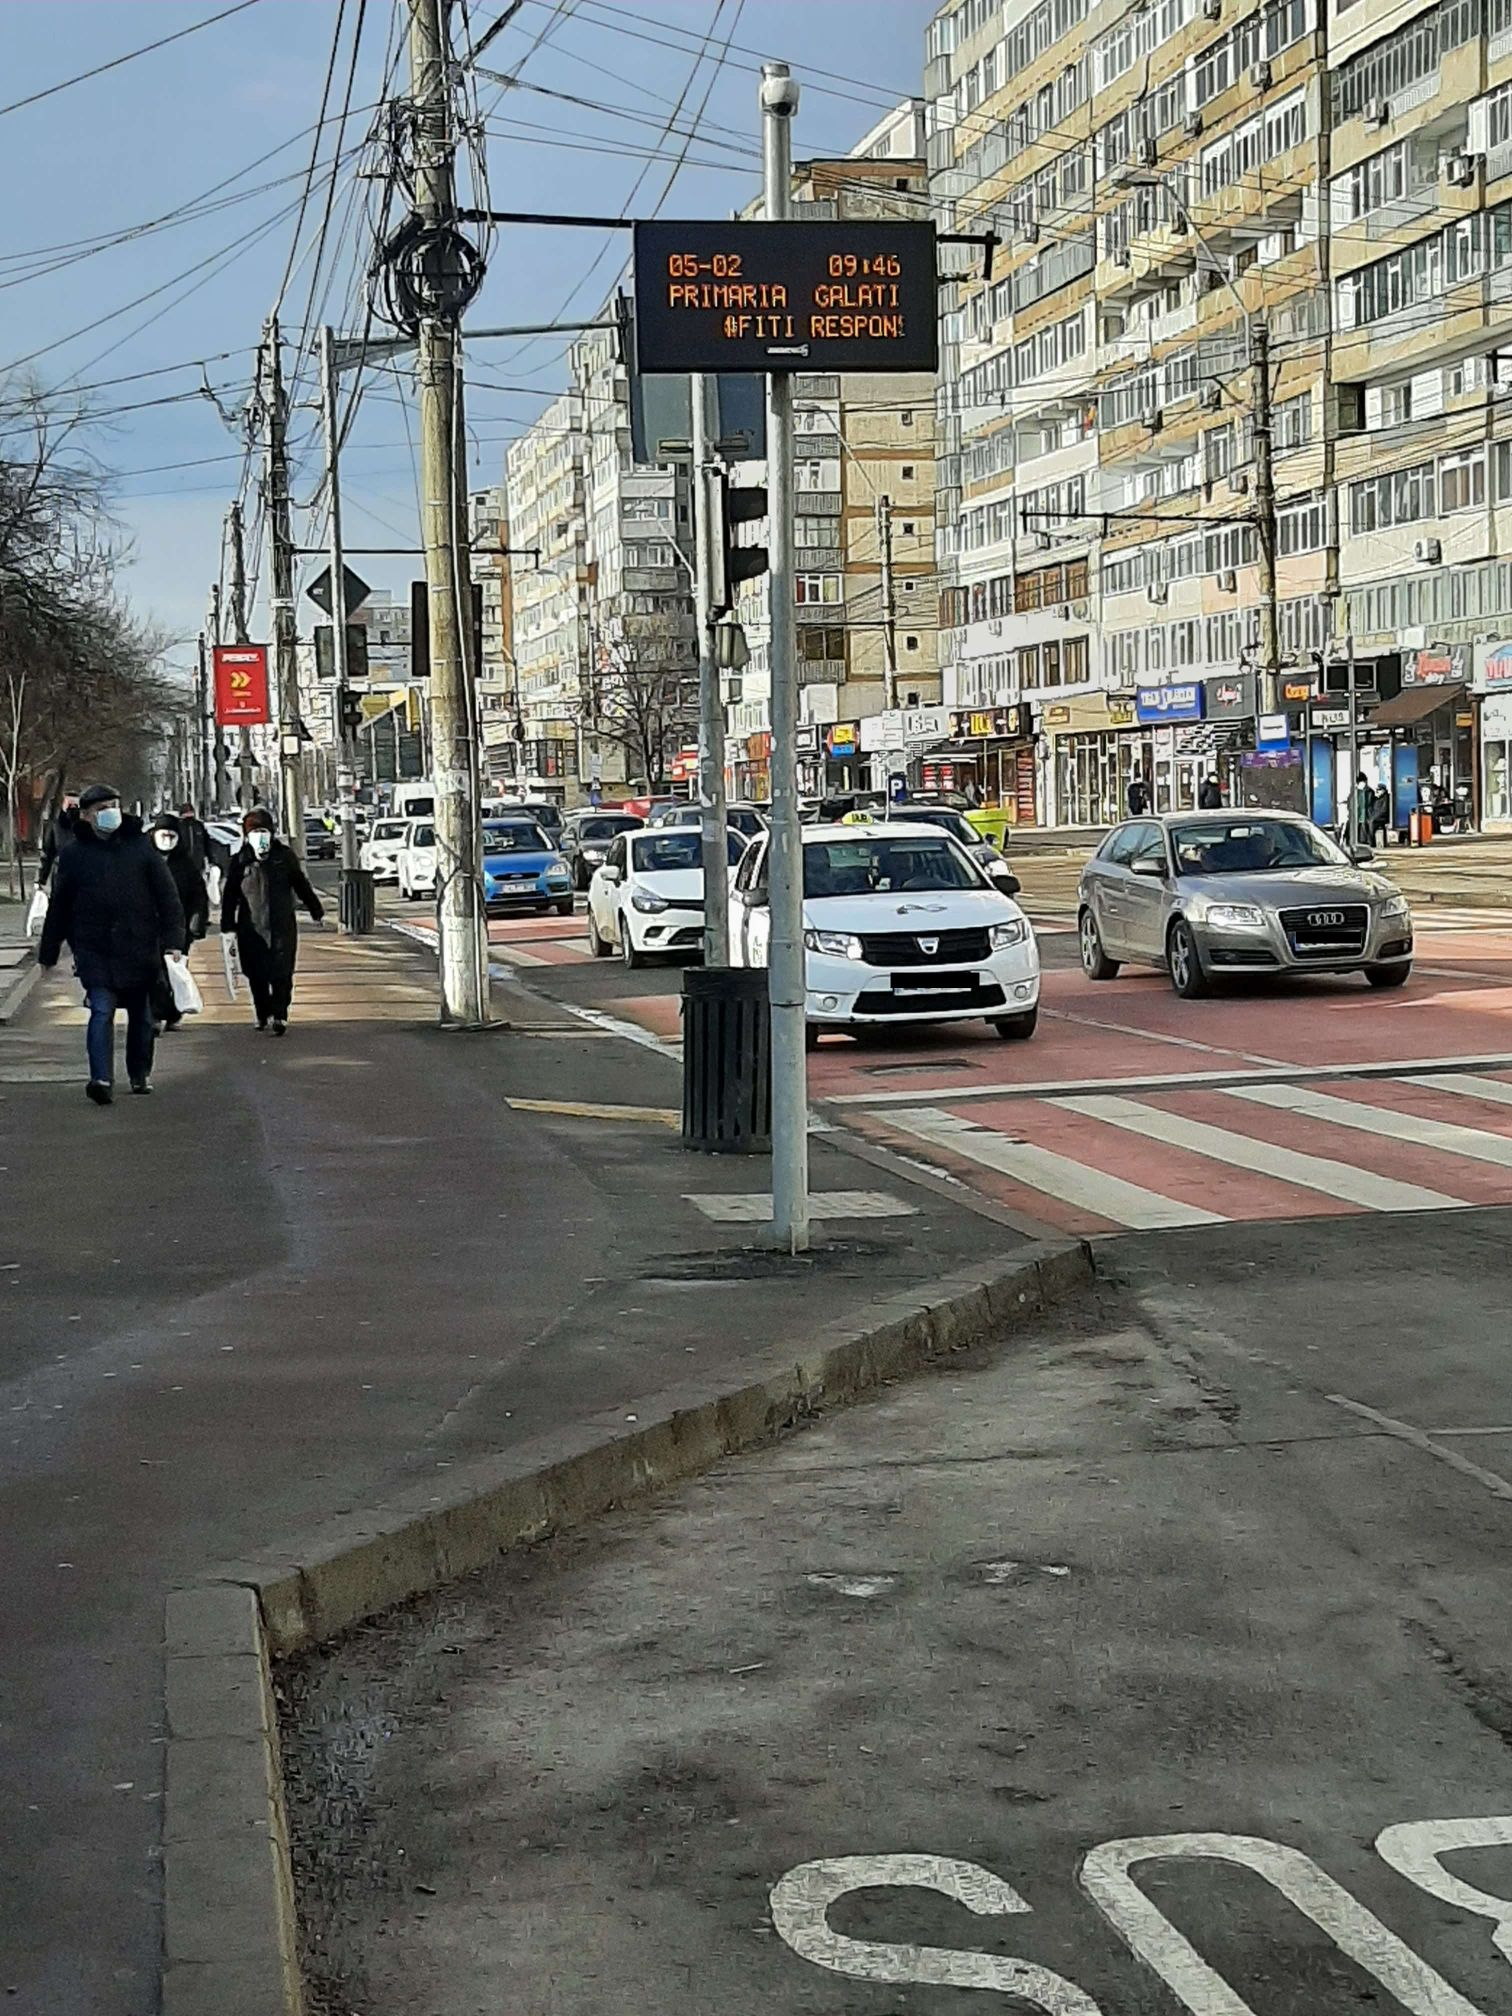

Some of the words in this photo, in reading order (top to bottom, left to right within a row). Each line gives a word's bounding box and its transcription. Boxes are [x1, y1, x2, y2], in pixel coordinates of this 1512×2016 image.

[669, 254, 742, 277] 05-02
[829, 254, 901, 277] 09:46
[669, 284, 786, 308] PRIMARIA
[815, 284, 897, 308] GALATI
[890, 779, 904, 797] P
